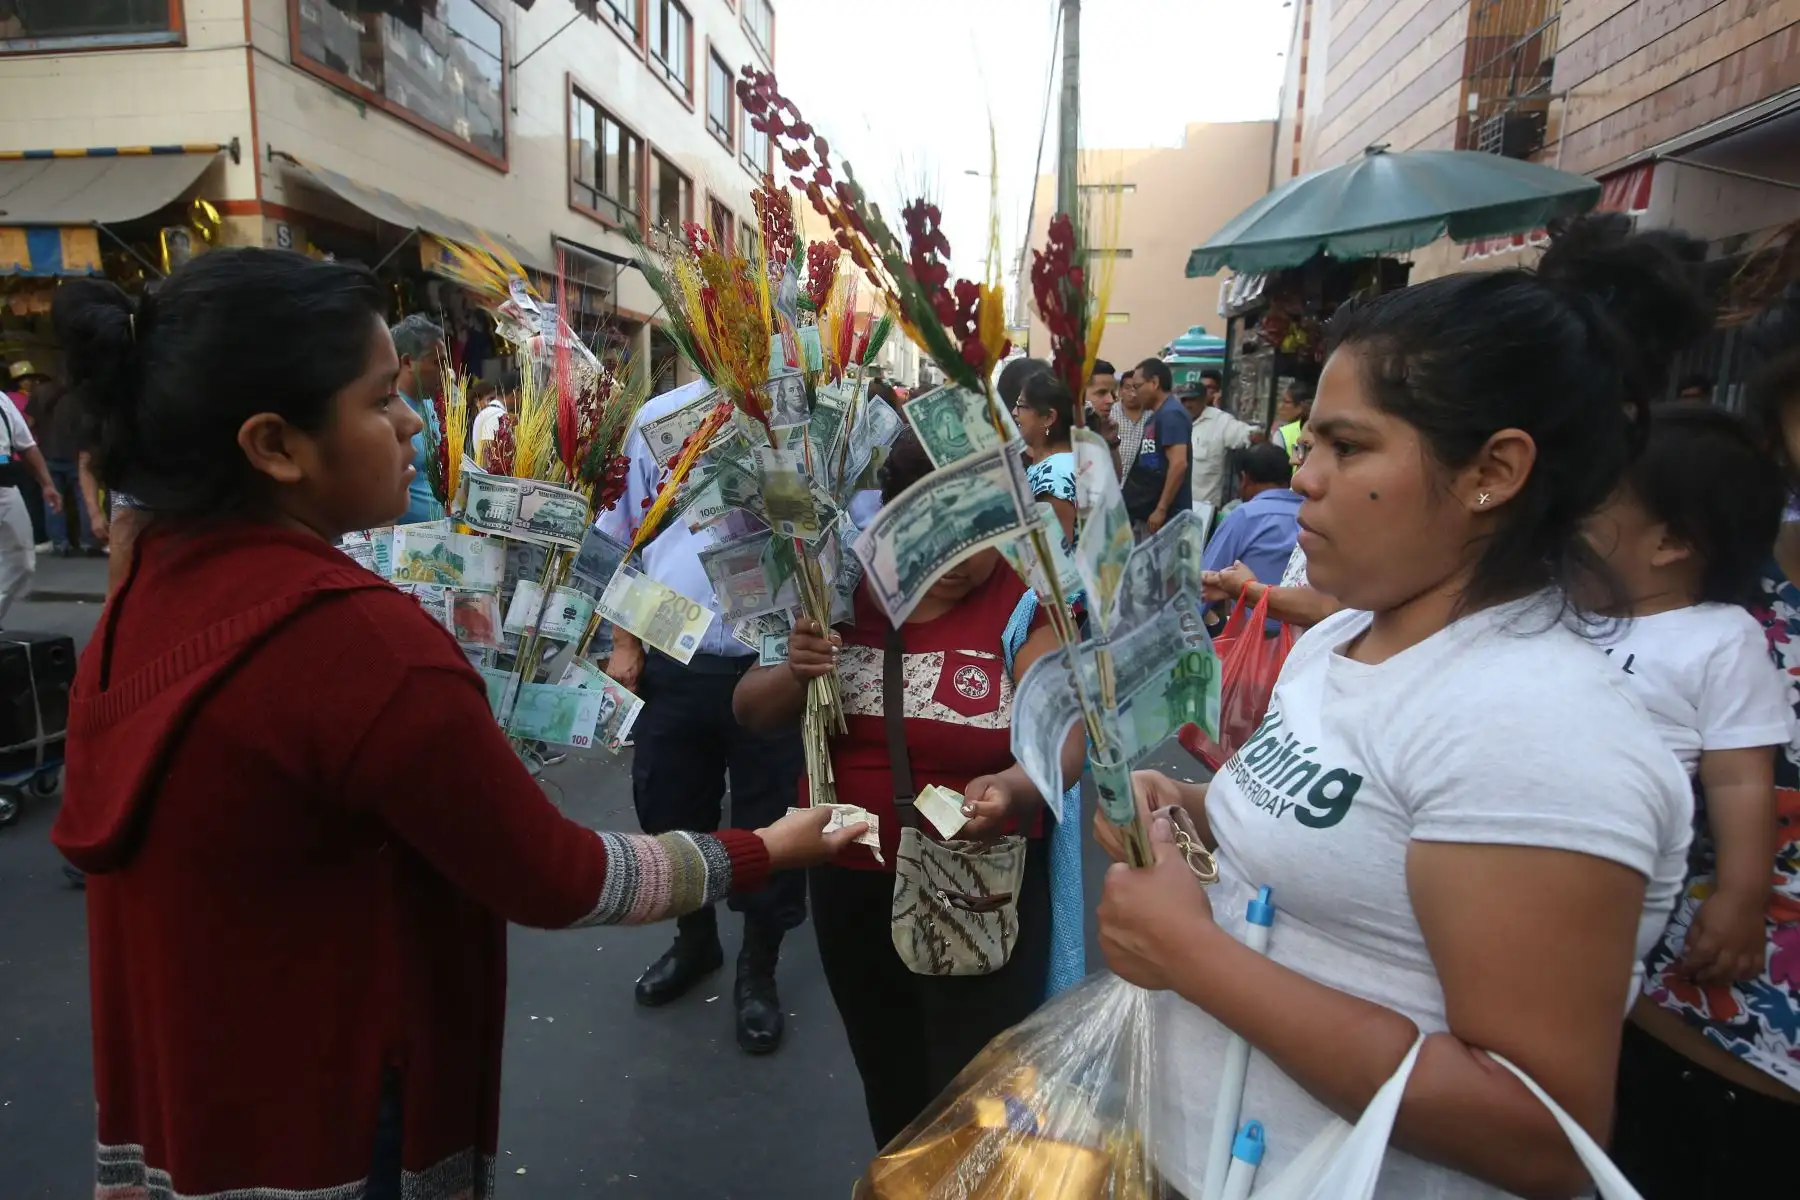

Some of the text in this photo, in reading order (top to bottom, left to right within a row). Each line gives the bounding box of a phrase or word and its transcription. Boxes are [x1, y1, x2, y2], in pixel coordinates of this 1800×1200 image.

[279, 226, 290, 247] S
[700, 508, 717, 518] 100
[395, 567, 410, 580] 10
[660, 589, 702, 622] 200
[571, 734, 588, 746] 100
[1231, 762, 1295, 819] FOR FRIDAY
